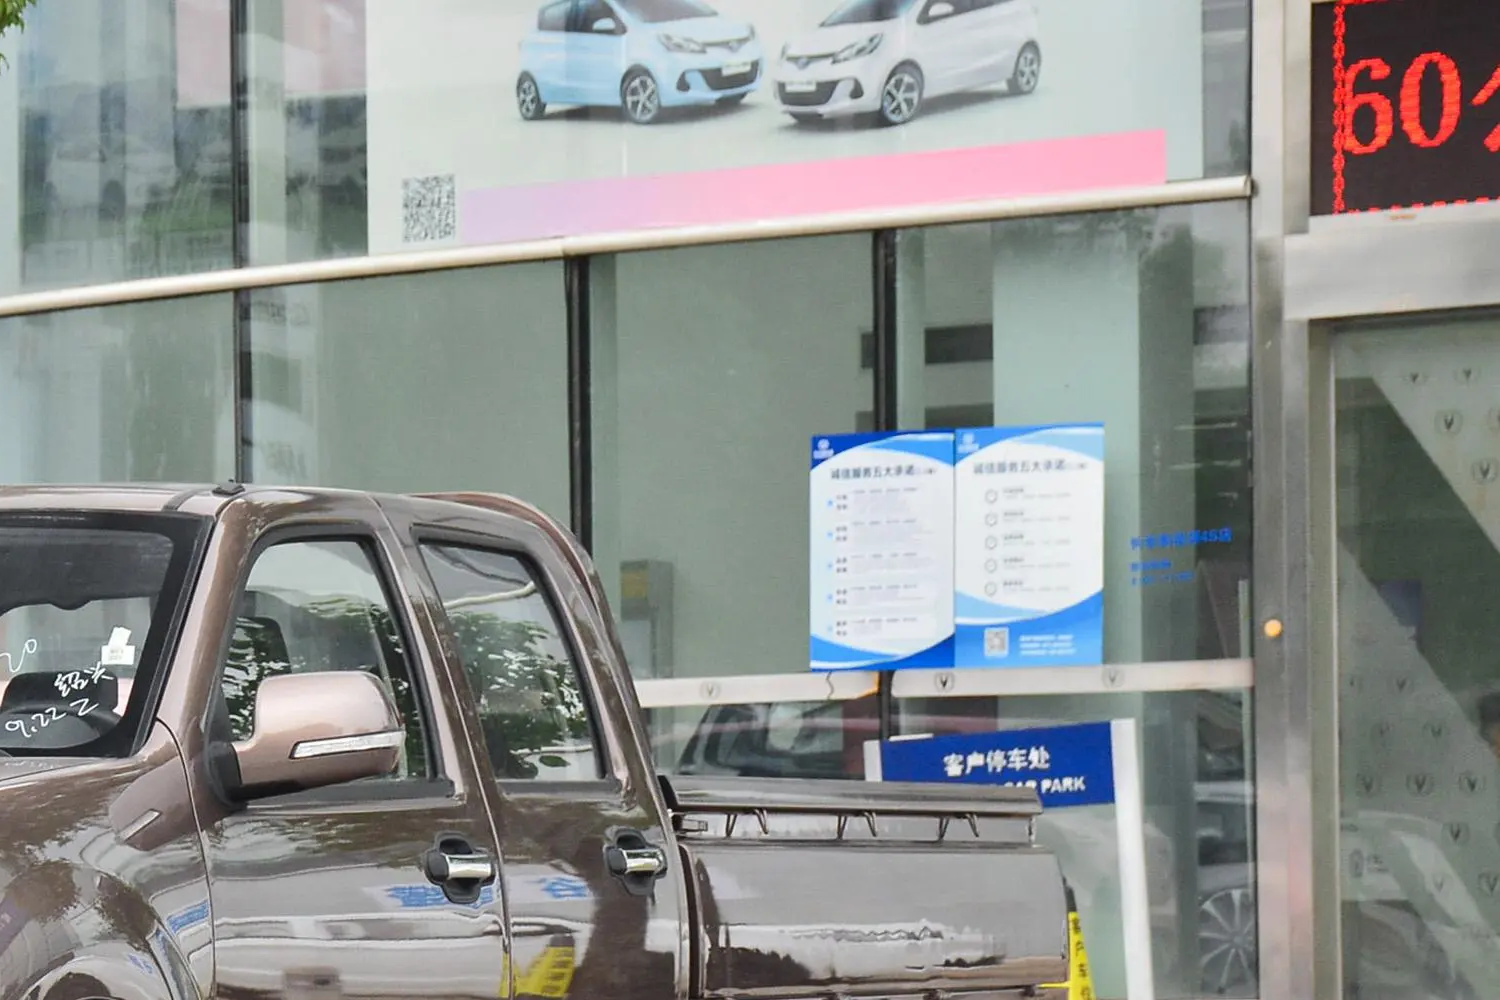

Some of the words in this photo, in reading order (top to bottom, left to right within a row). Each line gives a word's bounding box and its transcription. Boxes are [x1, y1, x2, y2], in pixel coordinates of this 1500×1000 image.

[943, 745, 1050, 777] 客户停车处
[1040, 775, 1086, 794] PARK
